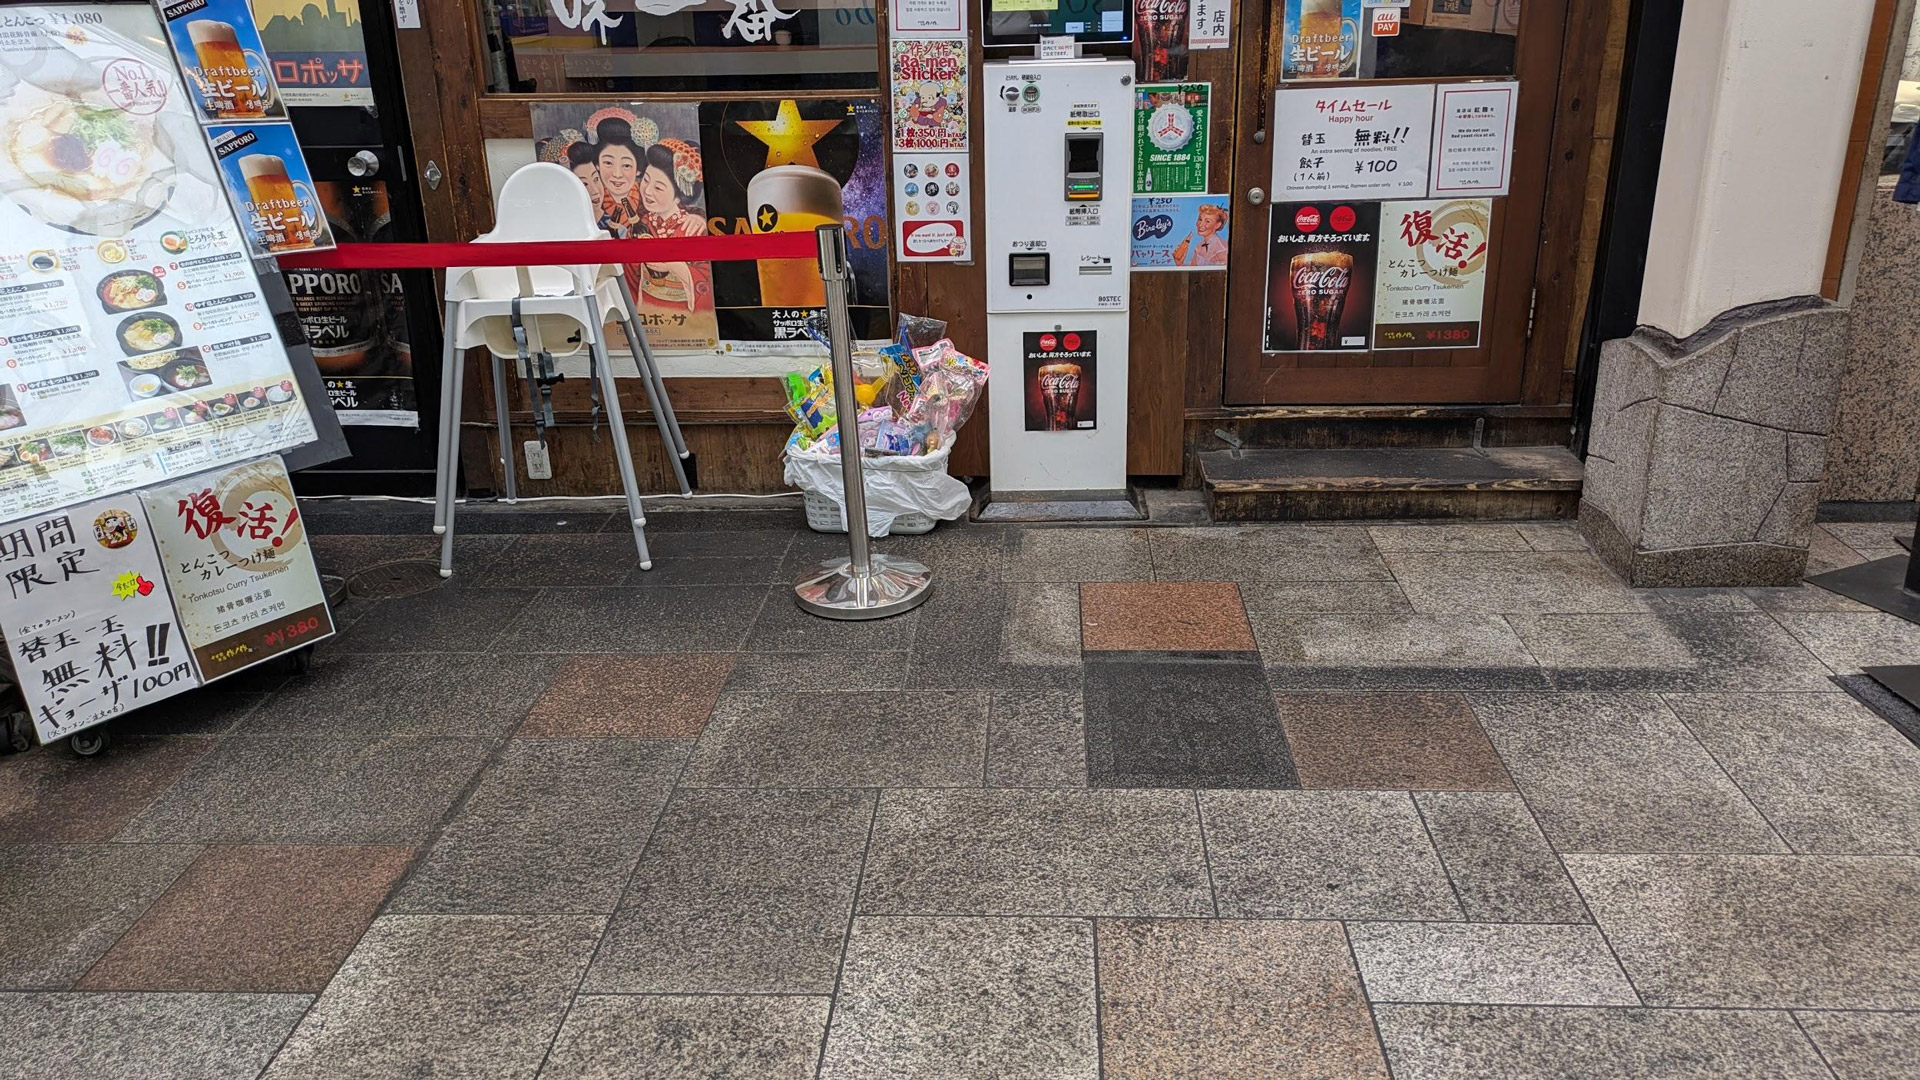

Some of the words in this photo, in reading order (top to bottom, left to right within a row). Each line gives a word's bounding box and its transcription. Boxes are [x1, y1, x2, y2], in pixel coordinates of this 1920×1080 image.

[166, 0, 205, 18] SAPPORO
[1377, 12, 1395, 21] au
[50, 12, 103, 25] ¥1,080
[1213, 9, 1226, 36] 店内
[1377, 23, 1394, 32] PAY
[1292, 34, 1351, 44] Draftbeer
[900, 55, 957, 68] Ra-men
[1289, 47, 1351, 63] 生ビール
[113, 65, 148, 82] No.1
[194, 65, 261, 77] Draftbeer
[901, 67, 956, 80] Sticker
[201, 77, 267, 98] 生ビール
[1315, 99, 1392, 114] タイムセール
[1328, 115, 1353, 124] Happy
[1355, 114, 1374, 122] hour
[218, 132, 255, 156] SAPPORO
[1300, 133, 1326, 147] 替玉
[1353, 126, 1410, 147] 無料!!
[1149, 154, 1172, 162] SINCE
[1173, 153, 1191, 161] 1884
[1299, 157, 1325, 169] 餃子
[244, 198, 309, 212] Draftbeer
[250, 210, 315, 233] 生ビール
[1400, 210, 1487, 269] 復活!
[1388, 259, 1426, 269] とんこつ
[1400, 267, 1458, 278] カレーつけ麺
[288, 273, 361, 295] PPORO
[1292, 266, 1350, 289] Coca-Cola
[1386, 284, 1413, 292] Tonkotsu
[1414, 284, 1431, 292] Curry
[1433, 283, 1465, 291] Tsukemen
[1426, 329, 1470, 340] ¥1380
[1041, 373, 1080, 390] Coca-Cola
[0, 515, 76, 563] 期間
[180, 550, 230, 574] とんこつ
[200, 547, 277, 582] カレーつけ麺
[5, 548, 100, 600] 限定
[188, 586, 225, 604] Tonkotsu
[226, 579, 249, 592] Curry
[249, 564, 290, 583] Tsukemen
[241, 610, 259, 623] 카레
[18, 614, 125, 664] 替玉一玉
[264, 616, 319, 647] ¥1380
[42, 621, 171, 699] 無料!!
[39, 661, 192, 730] ギョーザ100円
